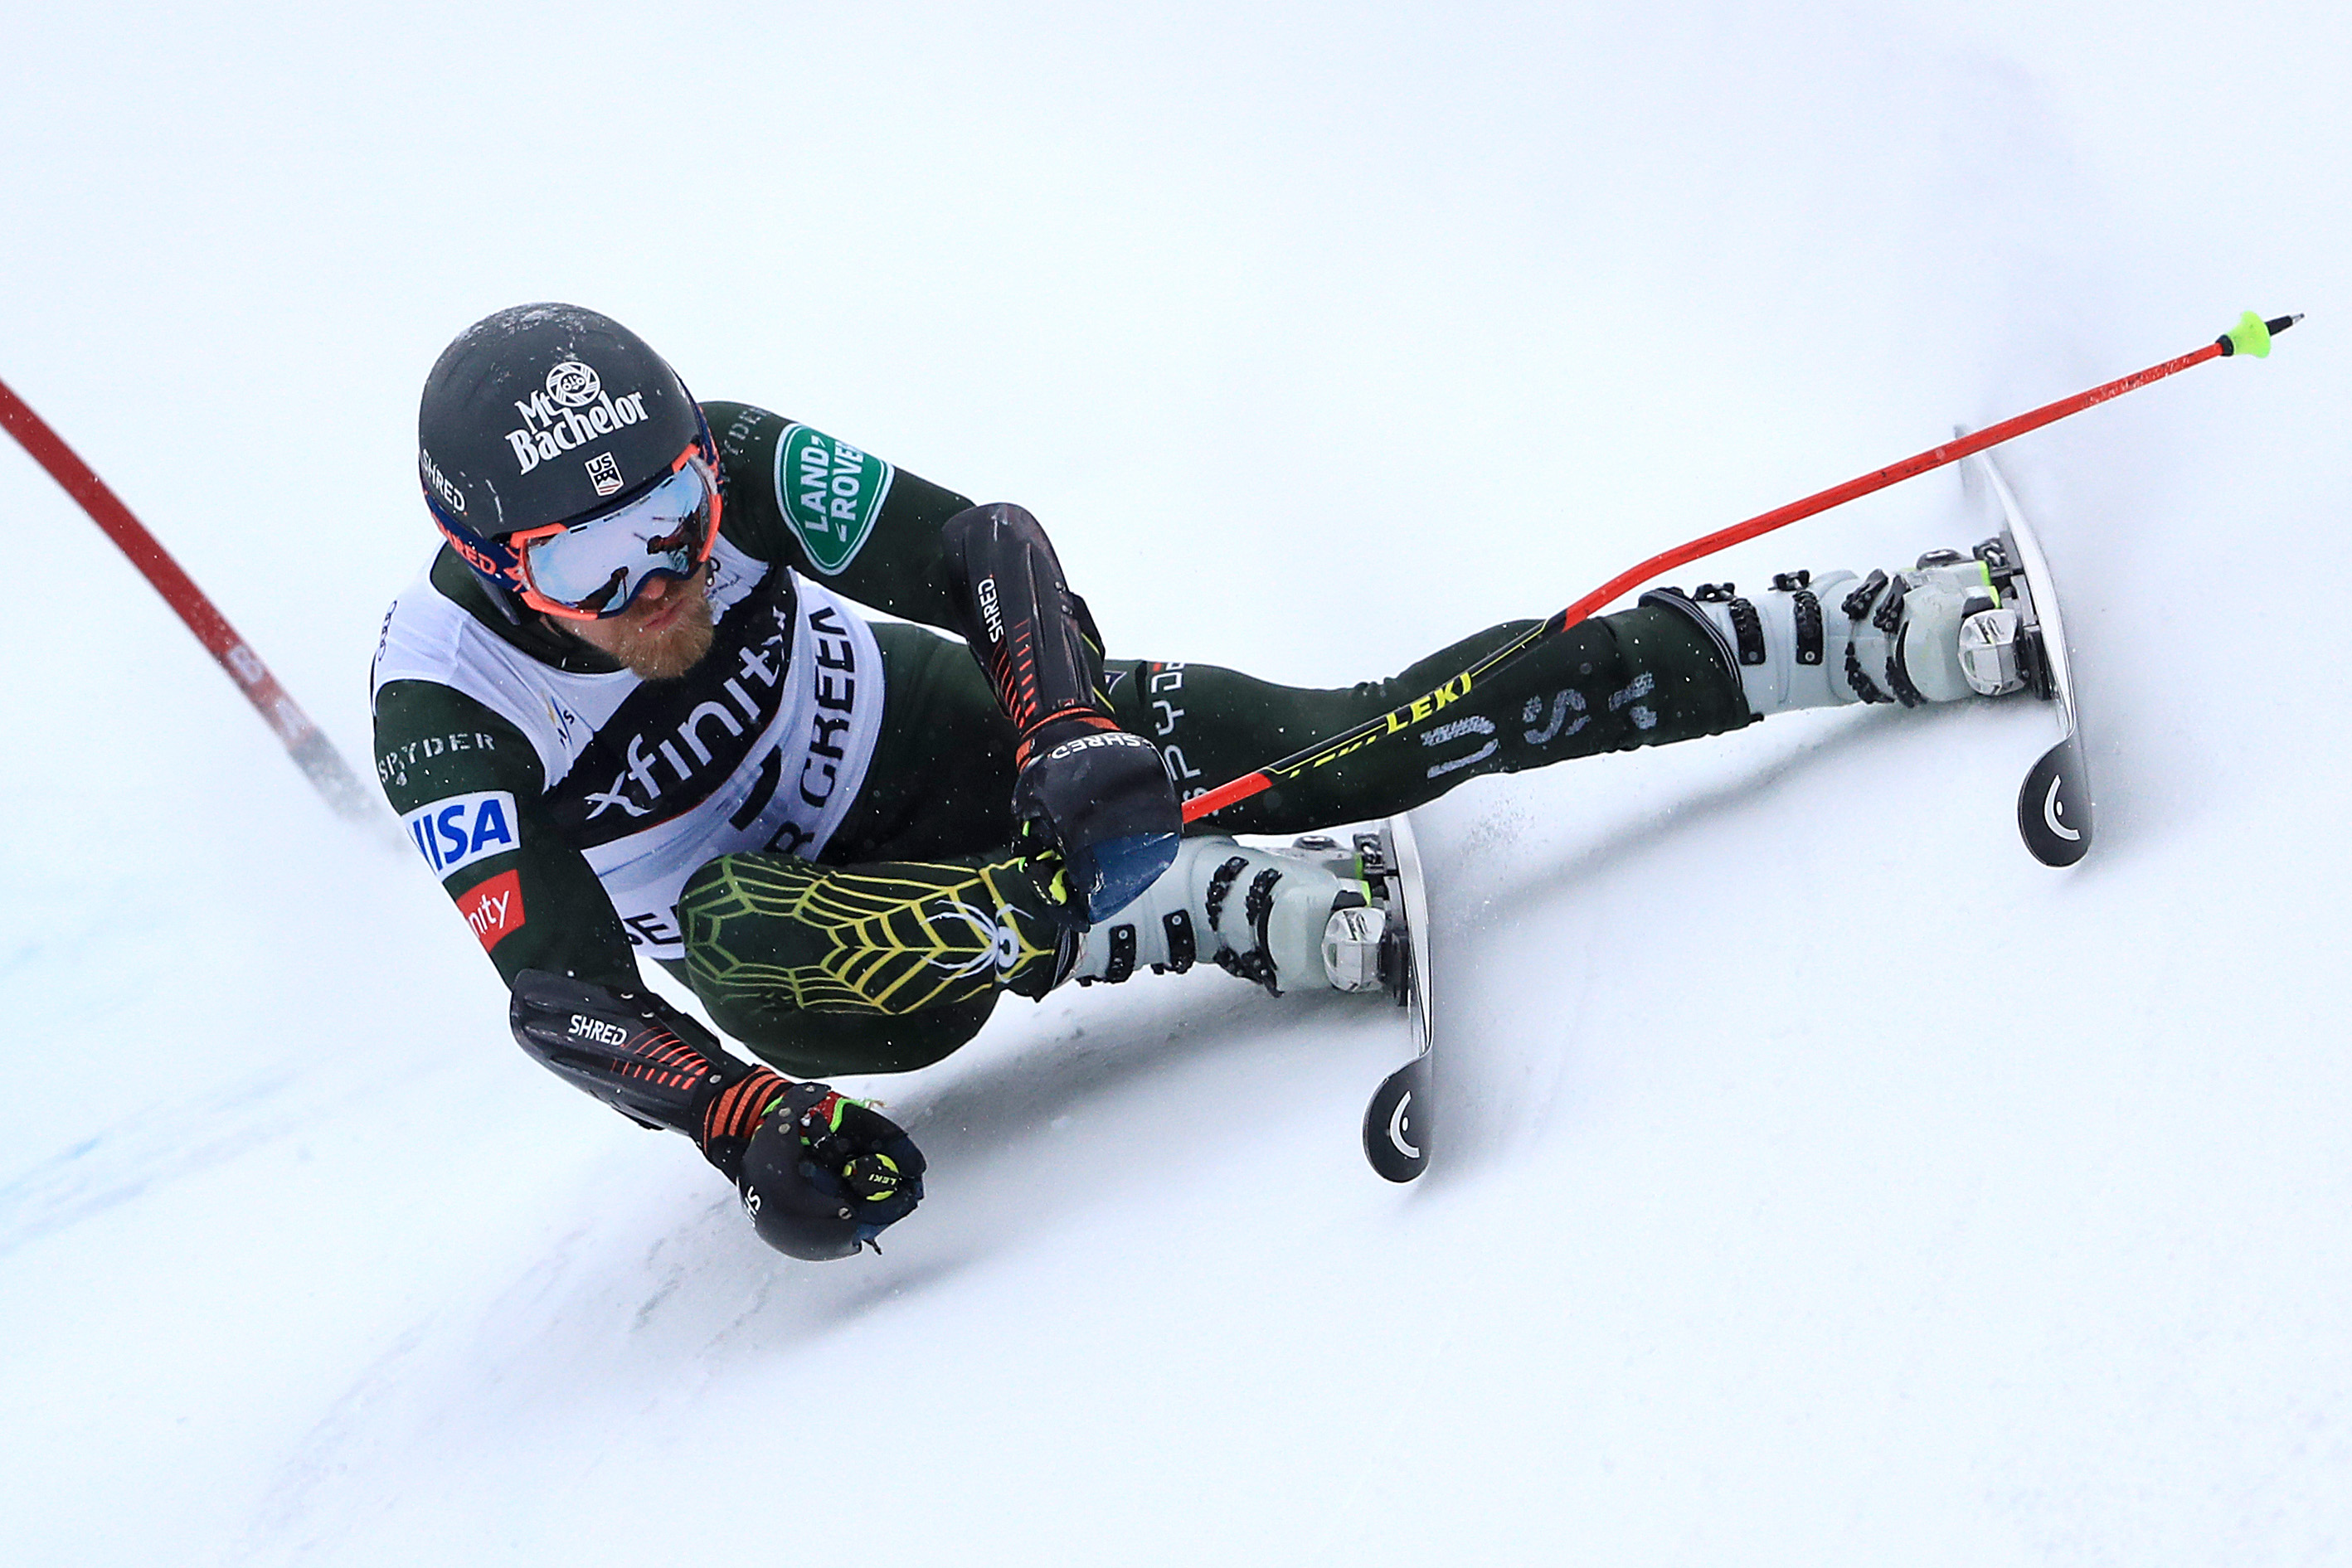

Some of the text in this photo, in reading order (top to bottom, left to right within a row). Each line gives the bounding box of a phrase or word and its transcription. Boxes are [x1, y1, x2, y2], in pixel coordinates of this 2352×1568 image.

[504, 390, 649, 475] Bachelor
[514, 390, 561, 434] Mt
[422, 449, 466, 512] SHRED
[588, 455, 613, 473] US
[800, 445, 830, 533] LAND
[830, 440, 864, 522] ROVE
[977, 577, 1004, 643] SHRED
[1386, 672, 1472, 734] LEKI
[378, 732, 495, 784] SPYDER
[1051, 734, 1141, 760] SHRED
[567, 1014, 627, 1046] SHRED
[868, 1172, 898, 1187] LEKI
